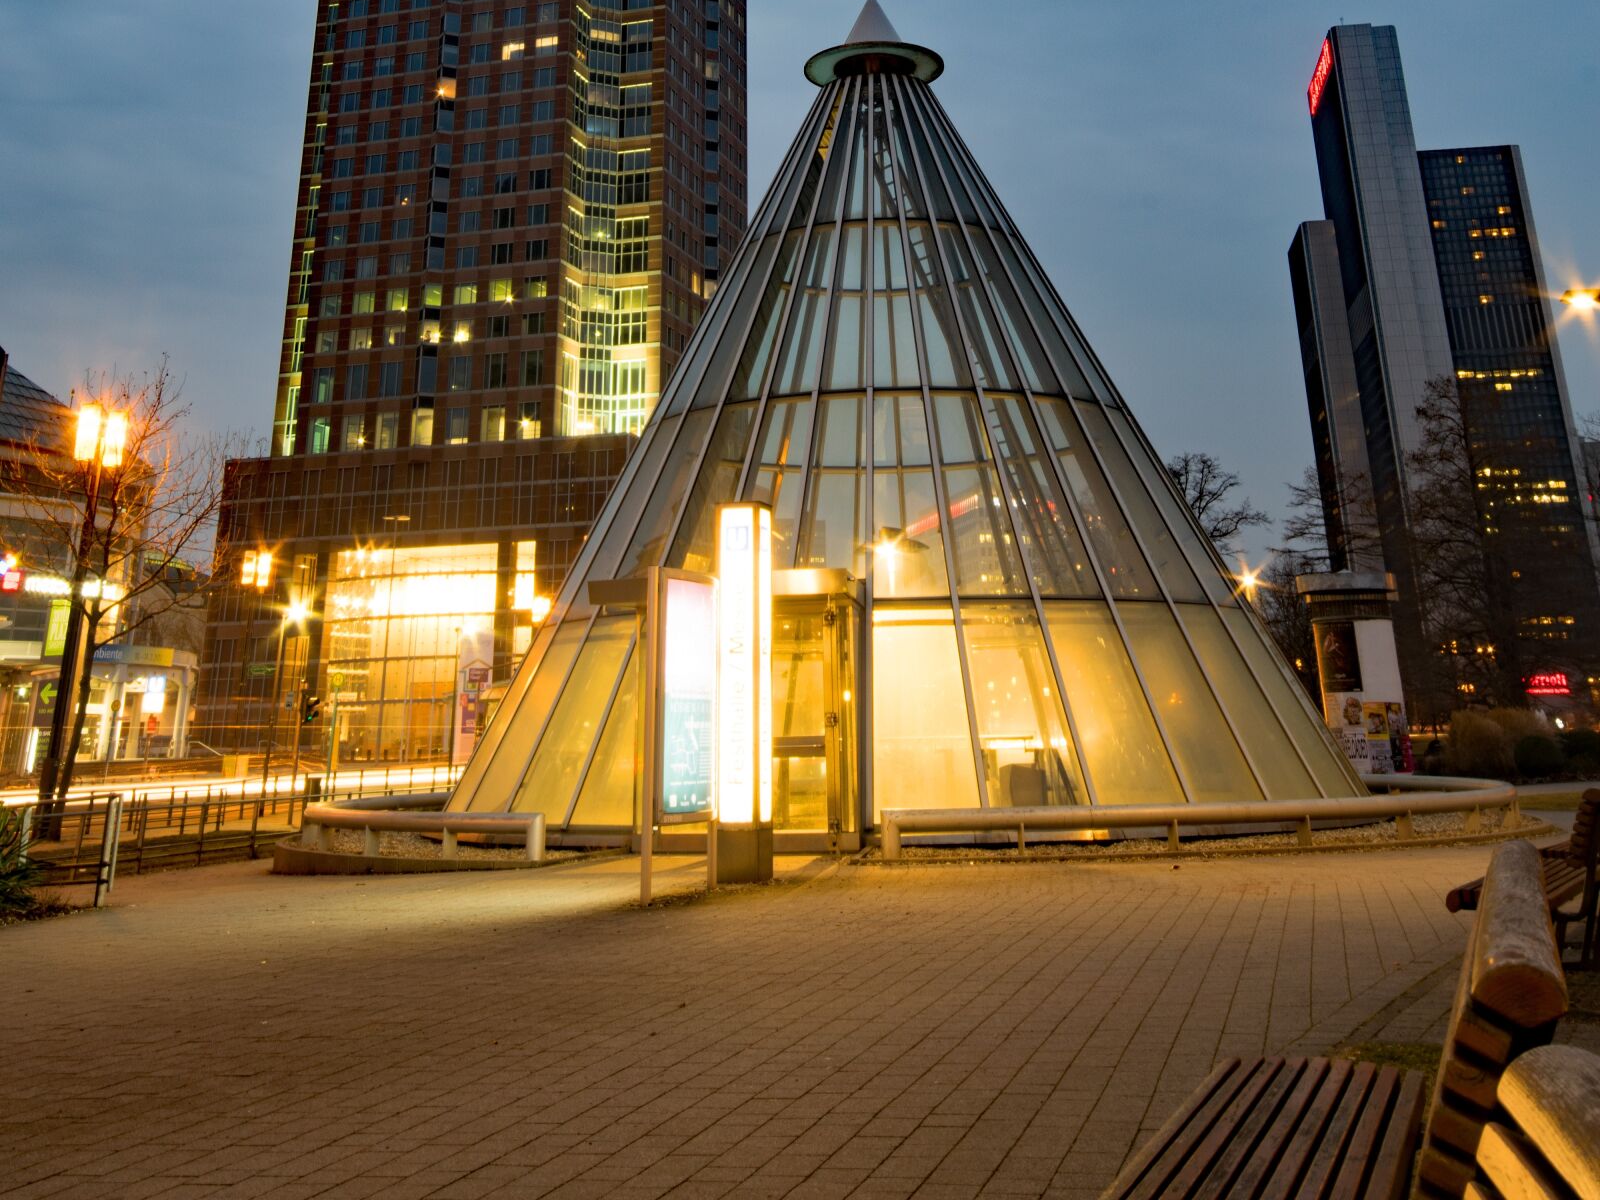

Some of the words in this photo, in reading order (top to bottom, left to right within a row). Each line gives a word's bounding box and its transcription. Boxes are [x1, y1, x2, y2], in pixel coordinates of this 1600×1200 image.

[94, 648, 123, 659] mbiente
[729, 583, 745, 656] Messe
[728, 681, 745, 785] Festhalle
